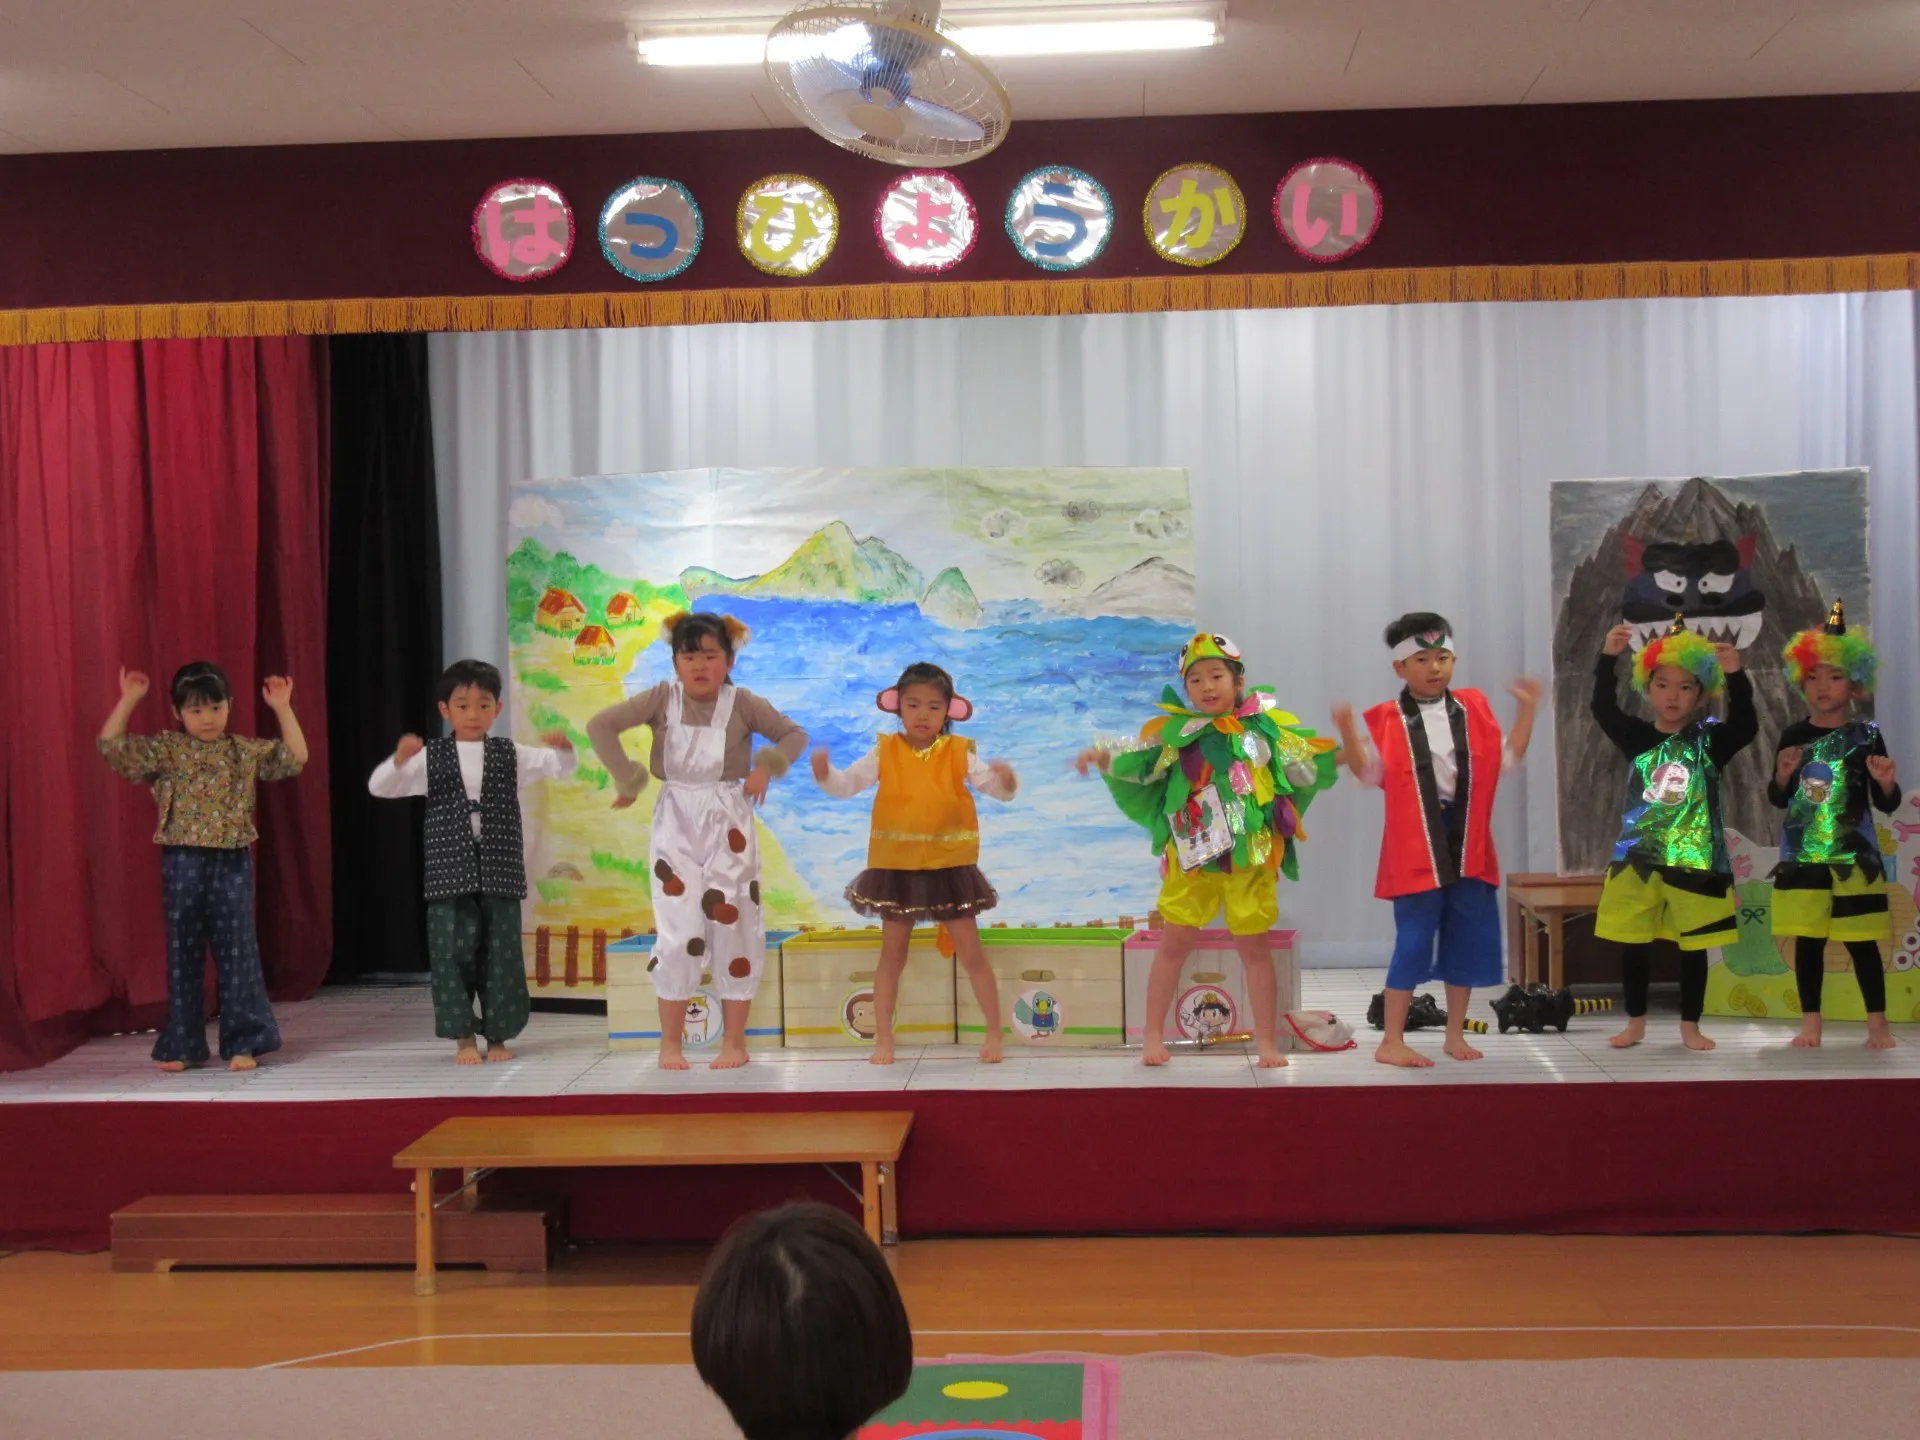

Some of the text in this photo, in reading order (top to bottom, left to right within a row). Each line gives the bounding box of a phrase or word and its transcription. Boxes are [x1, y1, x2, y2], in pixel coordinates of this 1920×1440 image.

[486, 179, 1358, 267] はっぴょうかい
